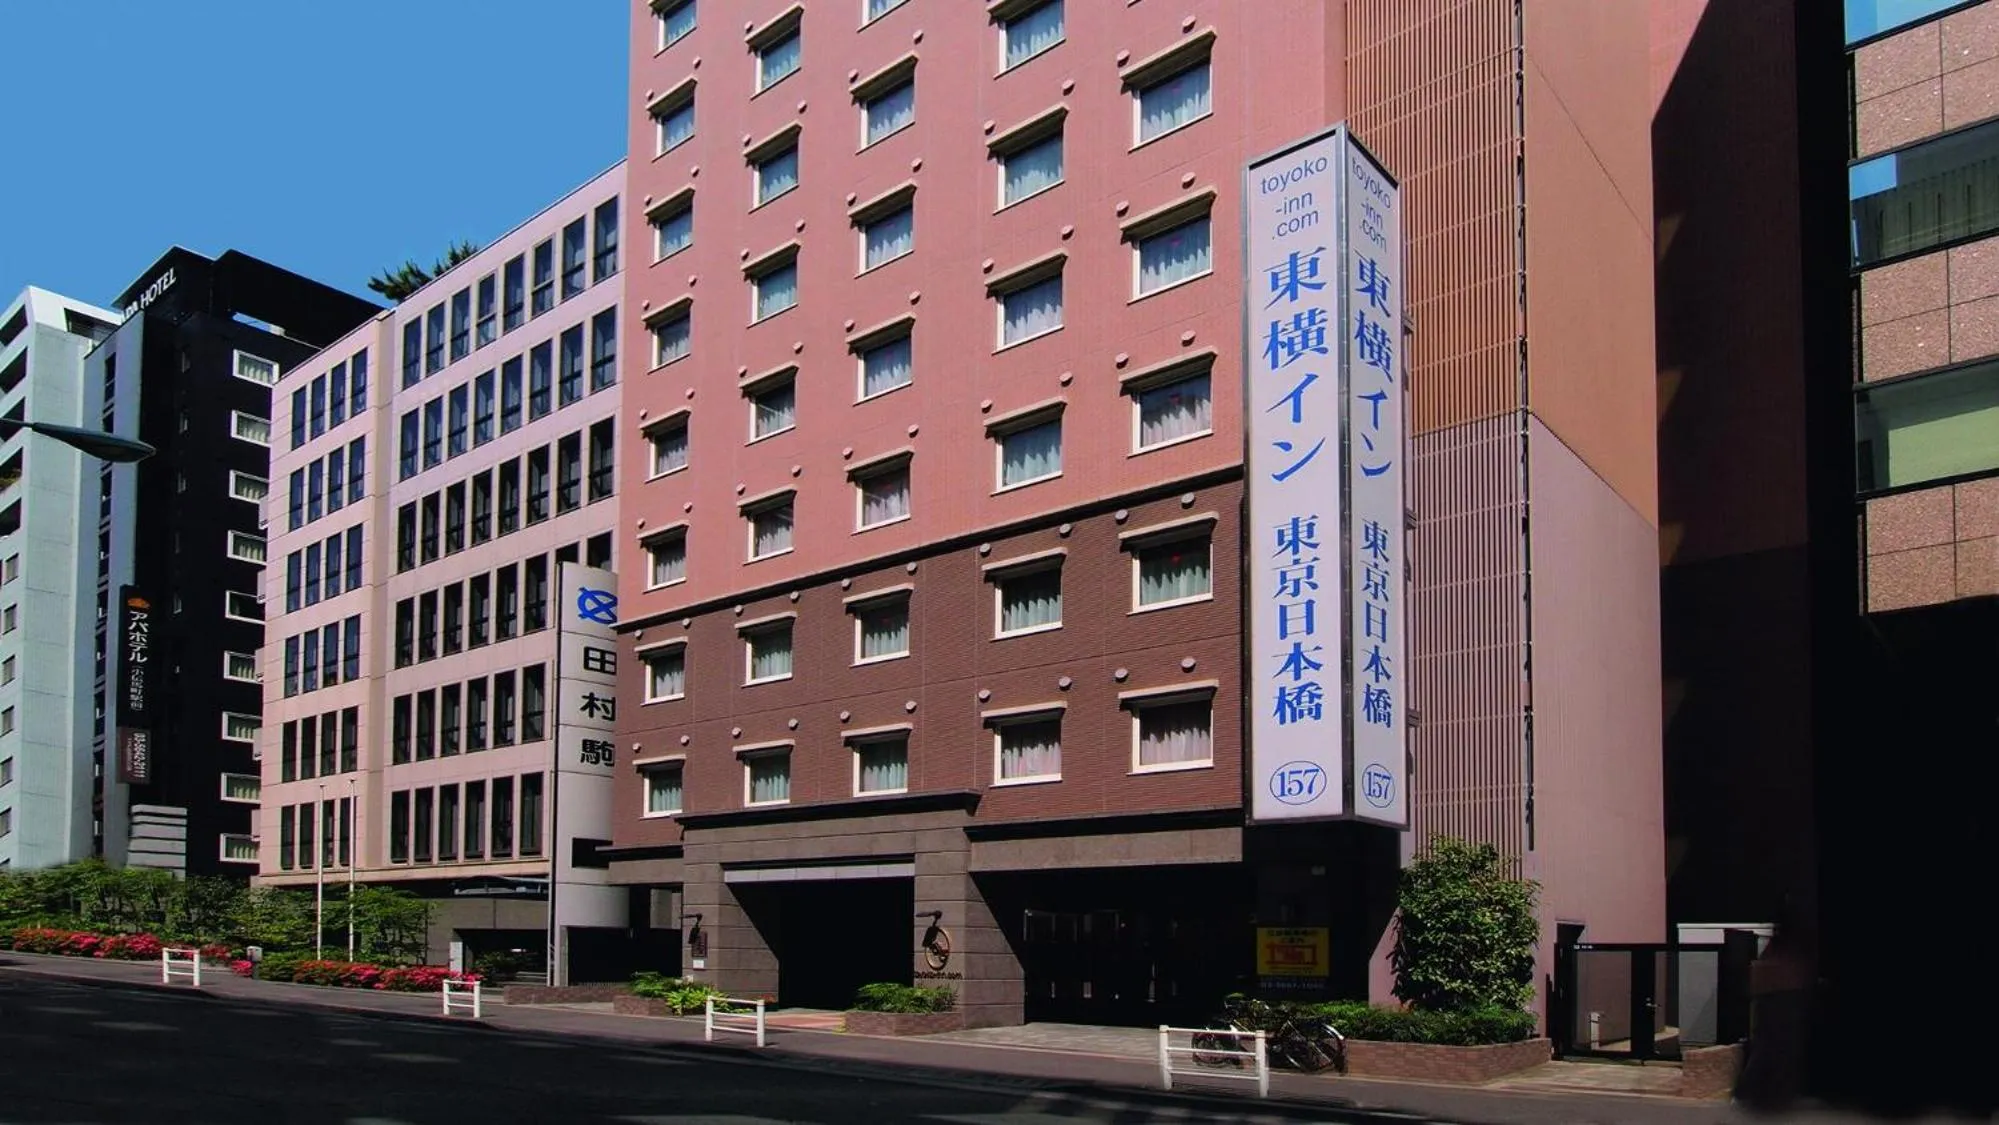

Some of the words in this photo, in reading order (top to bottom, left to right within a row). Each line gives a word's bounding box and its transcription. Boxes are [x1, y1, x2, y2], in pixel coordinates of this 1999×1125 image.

[1260, 156, 1328, 195] toyoko
[1352, 157, 1392, 209] toyoko
[1272, 210, 1319, 240] .com
[1275, 191, 1313, 215] -inn
[140, 267, 176, 309] HOTEL
[1263, 246, 1329, 482] 東横イン
[1355, 249, 1394, 477] 東横イン
[1271, 514, 1322, 725] 東京日本橋
[1360, 518, 1392, 728] 東京日本橋
[580, 646, 616, 766] 田村駒
[1277, 768, 1319, 798] 157
[1365, 771, 1392, 800] 157
